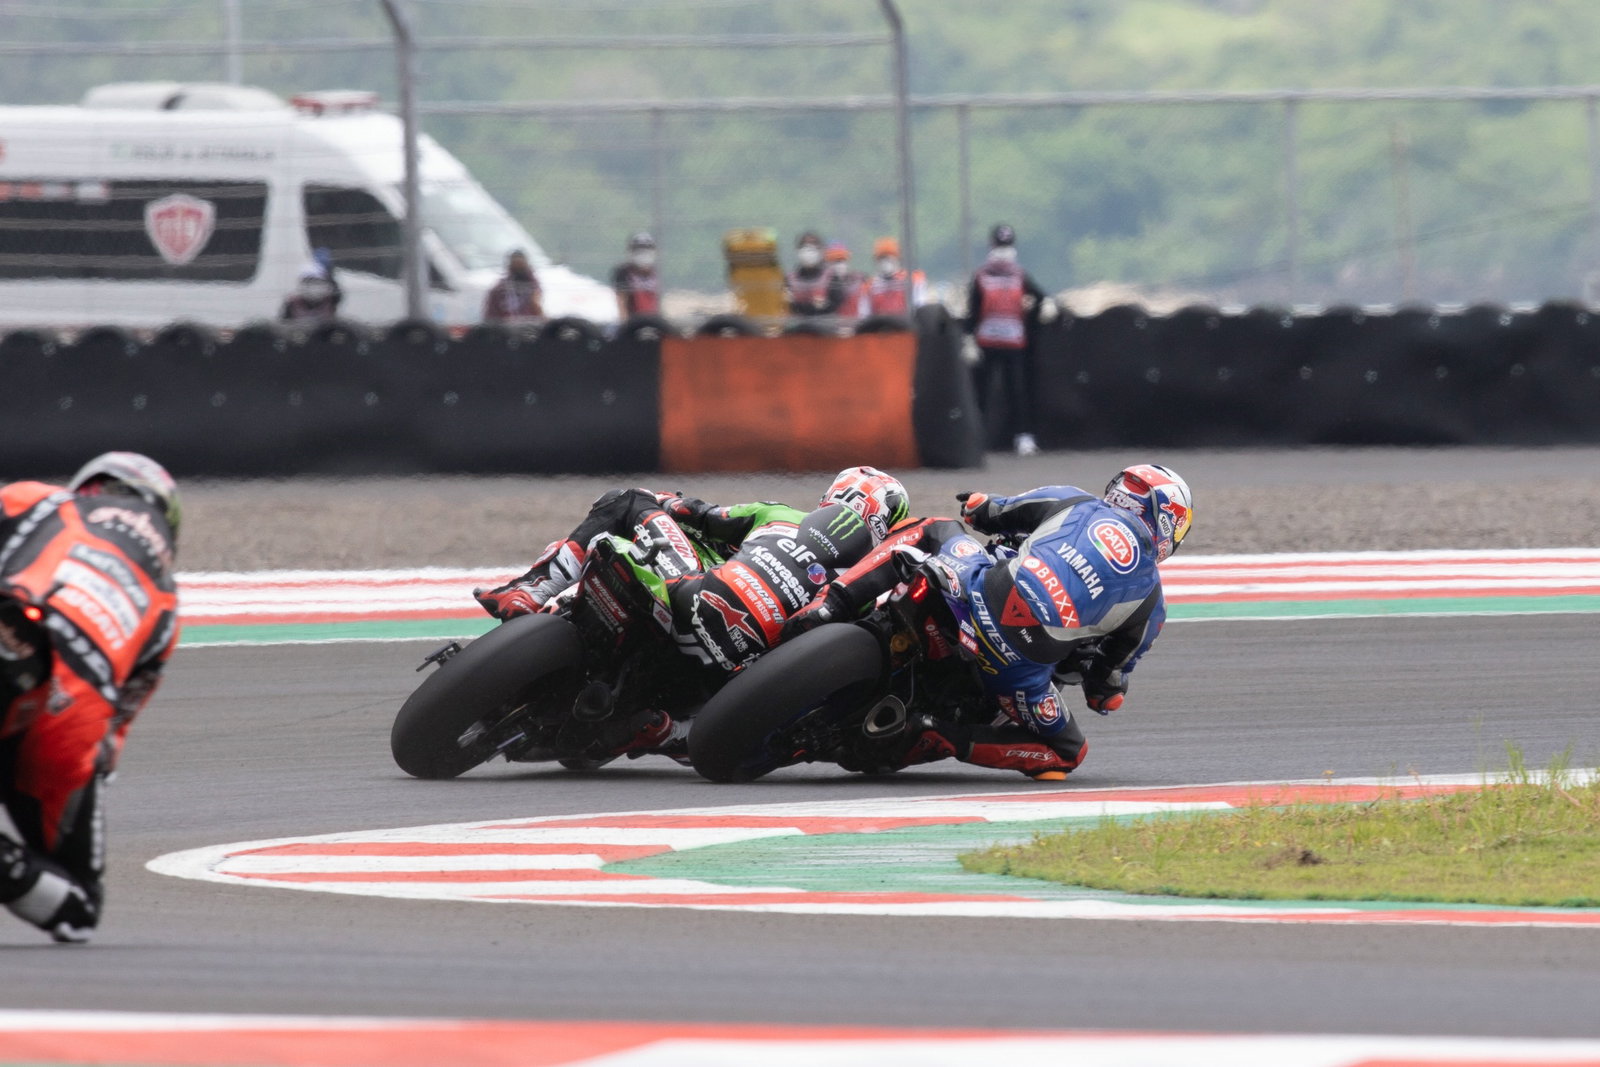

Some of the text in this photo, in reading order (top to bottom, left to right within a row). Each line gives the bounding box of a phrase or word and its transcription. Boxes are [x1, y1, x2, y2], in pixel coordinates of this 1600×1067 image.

[777, 538, 817, 565] elf
[808, 526, 839, 558] MONSTER
[1100, 527, 1129, 560] PATA
[749, 545, 812, 607] Kawasak
[751, 555, 781, 586] Racing
[779, 583, 799, 609] Team
[1036, 566, 1077, 627] BRIXX
[1057, 542, 1104, 600] YAMAHA
[971, 591, 1021, 662] DAINESE
